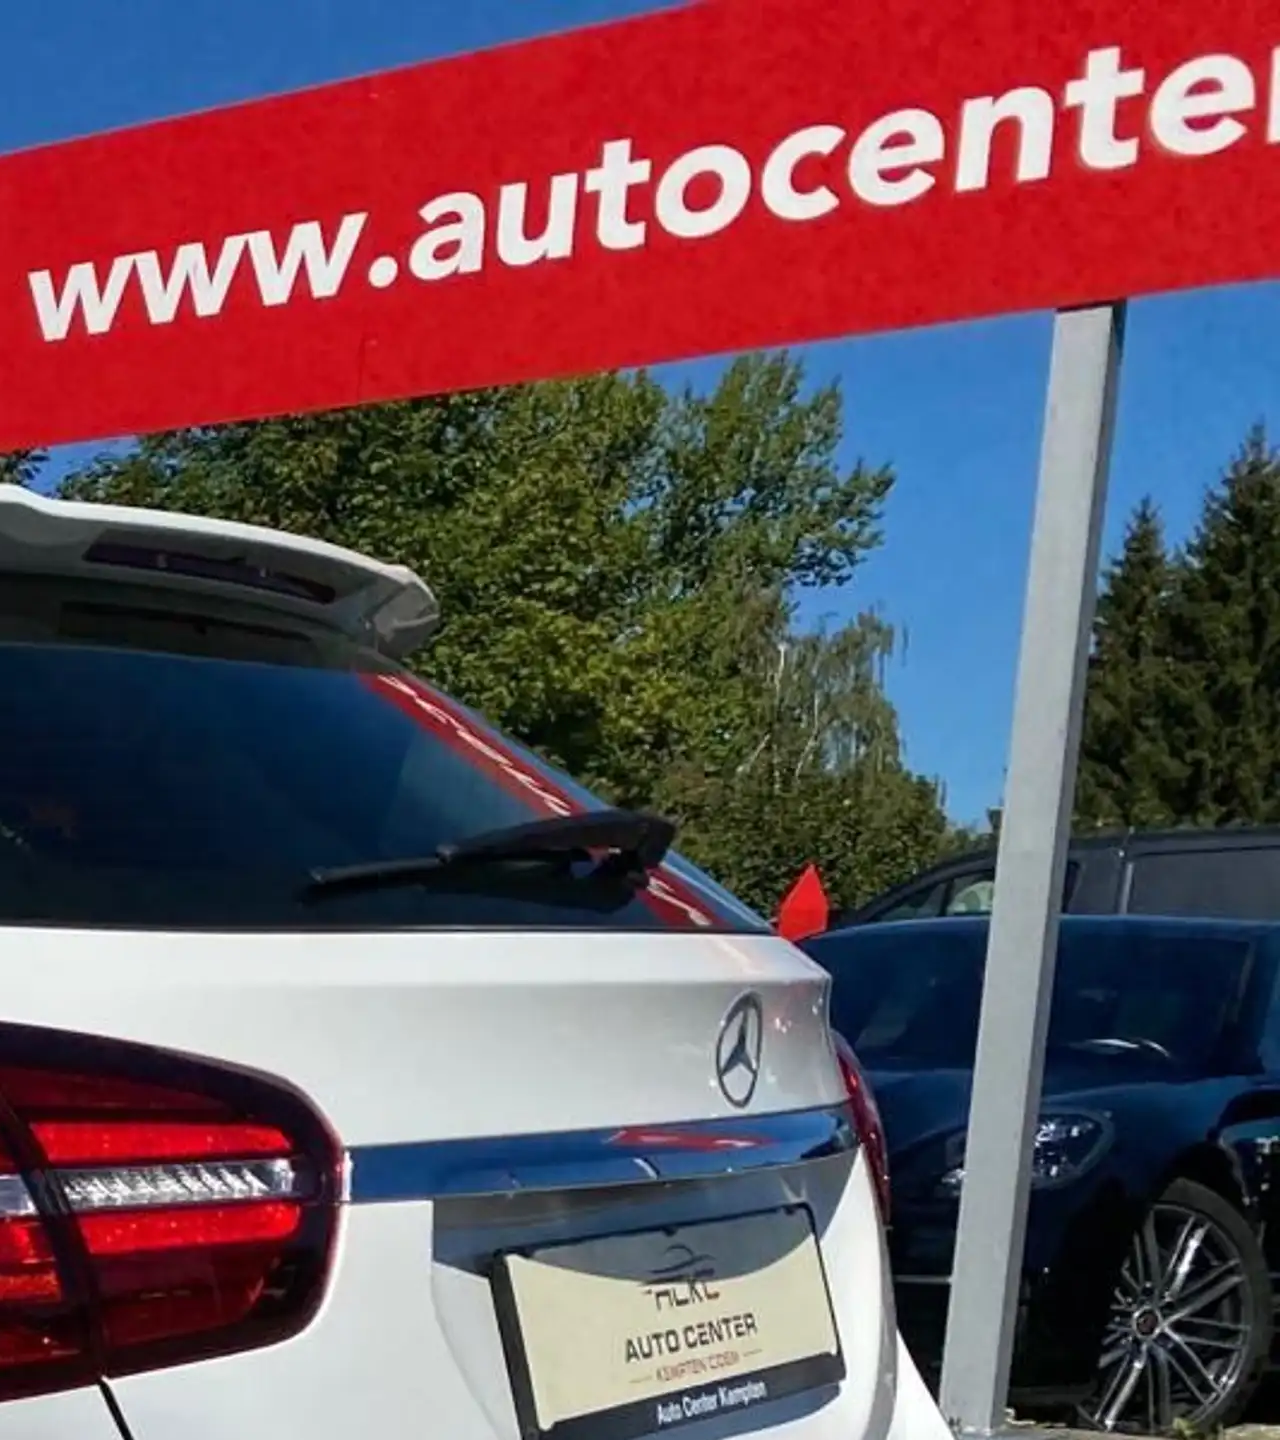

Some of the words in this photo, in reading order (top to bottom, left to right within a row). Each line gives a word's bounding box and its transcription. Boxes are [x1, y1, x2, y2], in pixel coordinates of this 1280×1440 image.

[624, 1329, 681, 1363] AUTO
[683, 1312, 758, 1349] CENTER
[682, 1392, 718, 1418] Center
